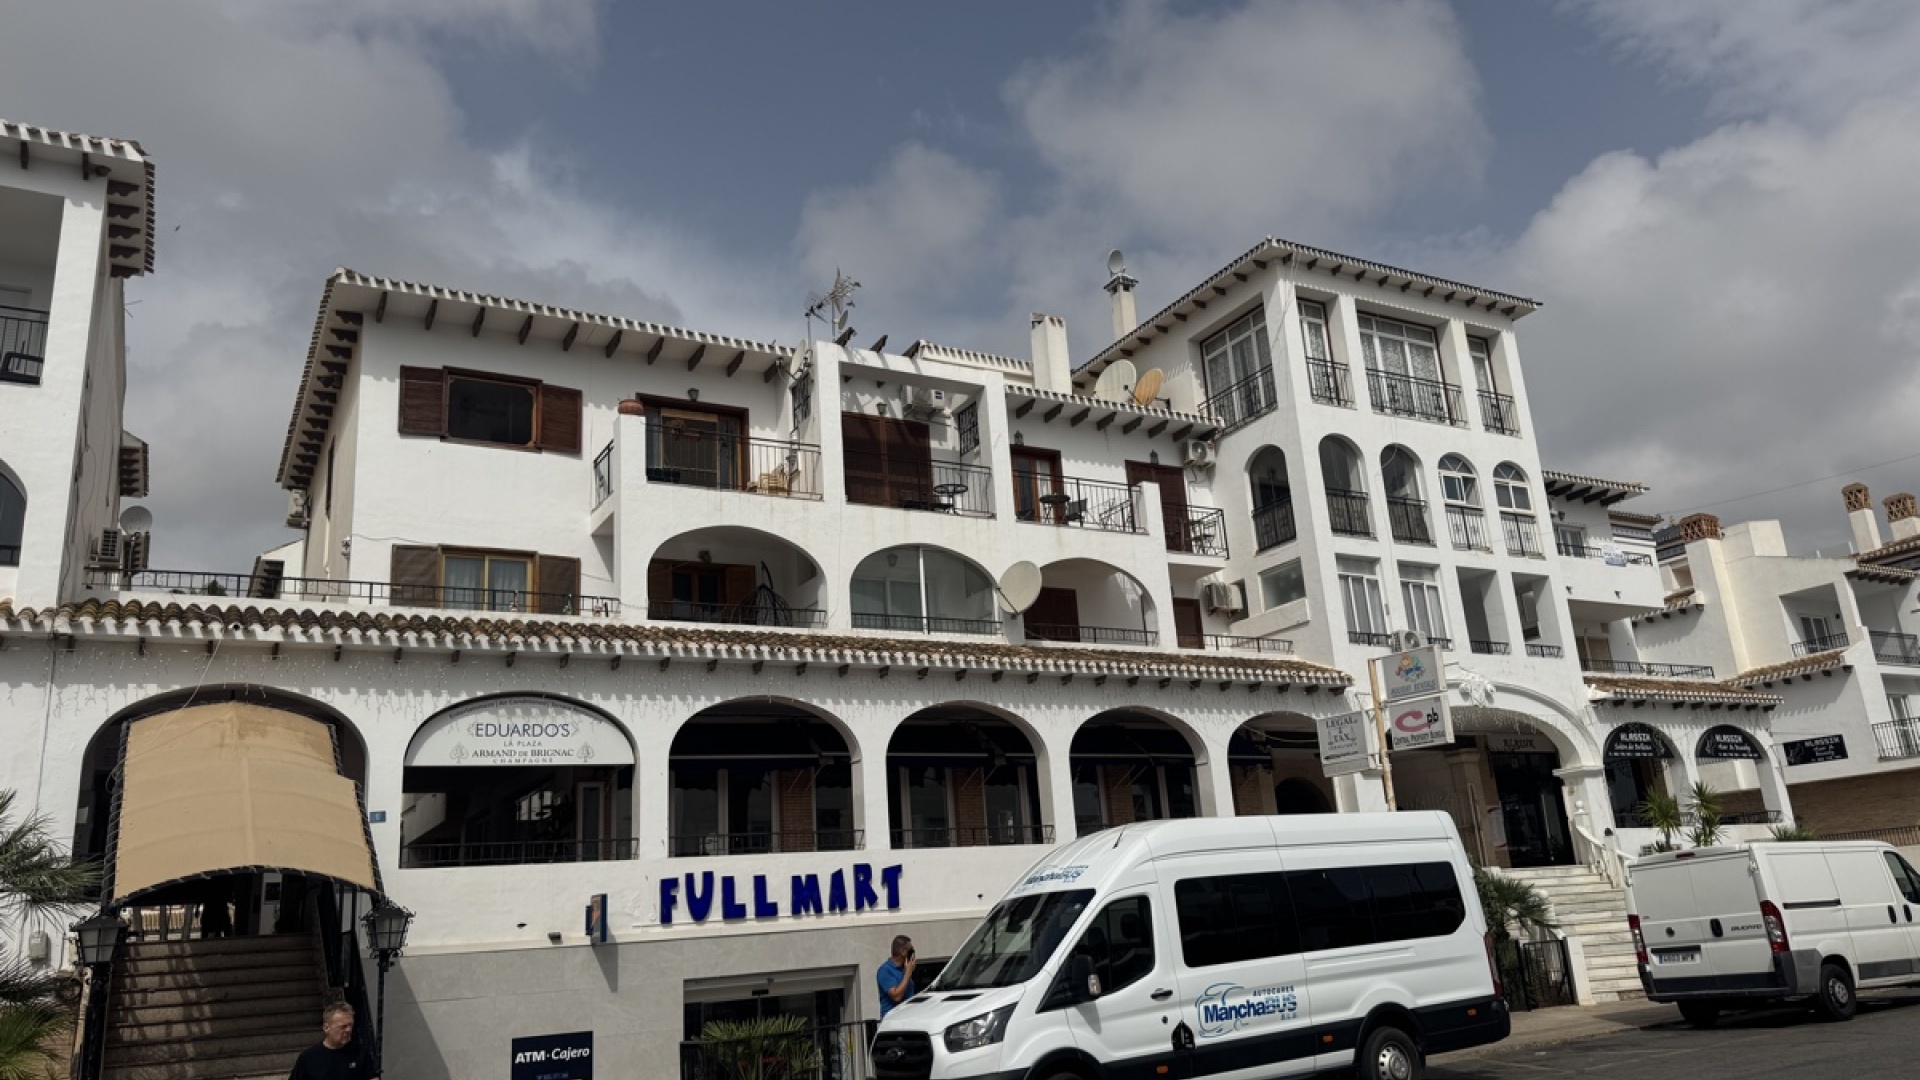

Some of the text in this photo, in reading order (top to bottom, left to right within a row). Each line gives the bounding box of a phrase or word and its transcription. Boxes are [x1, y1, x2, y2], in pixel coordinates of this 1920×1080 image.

[475, 723, 570, 738] EDUARDO'S
[472, 749, 517, 758] ARMAND
[530, 749, 574, 758] BRIGNAC
[659, 863, 903, 926] FULL MART
[1203, 995, 1297, 1023] ManchaBUS
[551, 1047, 590, 1061] Cajero
